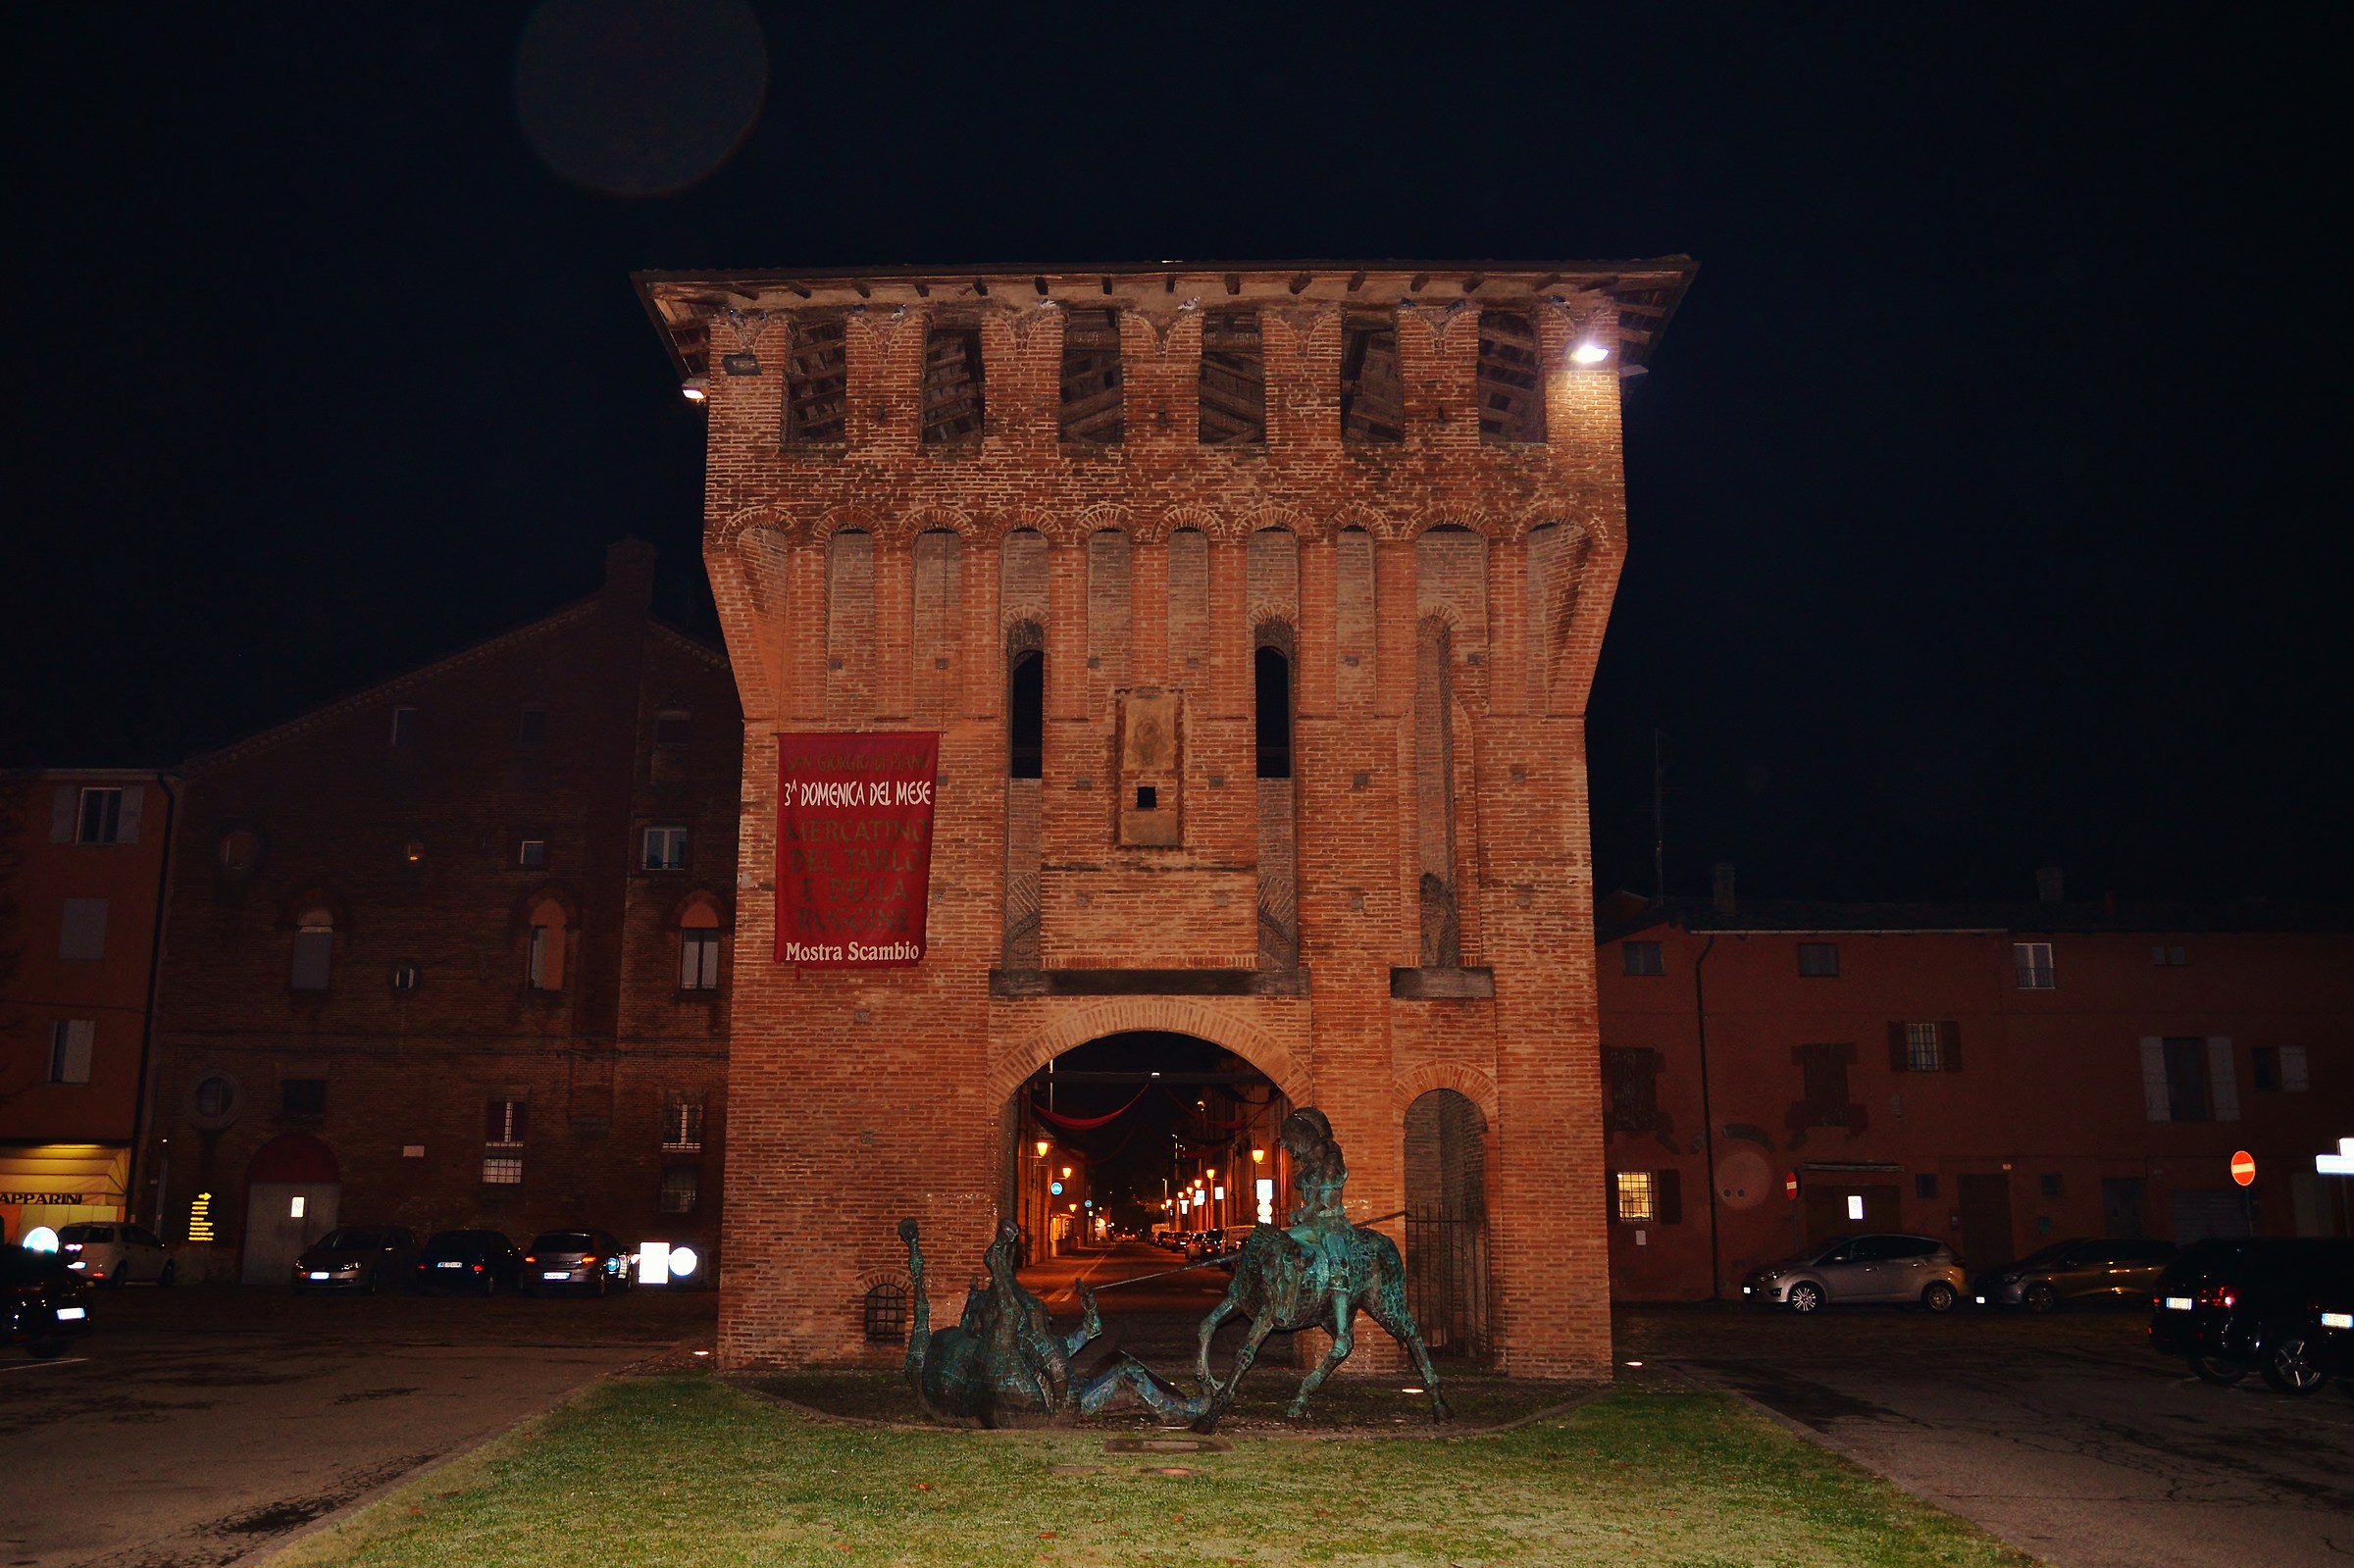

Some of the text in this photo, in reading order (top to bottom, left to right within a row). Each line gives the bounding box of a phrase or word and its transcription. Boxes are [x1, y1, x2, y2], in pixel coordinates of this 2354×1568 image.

[817, 753, 868, 771] GIORGIO
[800, 781, 865, 808] DOMENICA
[869, 781, 892, 806] DEL
[896, 781, 931, 805] MESE
[786, 818, 929, 842] MERCATINO
[792, 847, 923, 874] DEL TARLO
[802, 878, 907, 902] E DELLA
[797, 907, 910, 933] RUGGINE
[786, 940, 919, 961] Mostra Scambio
